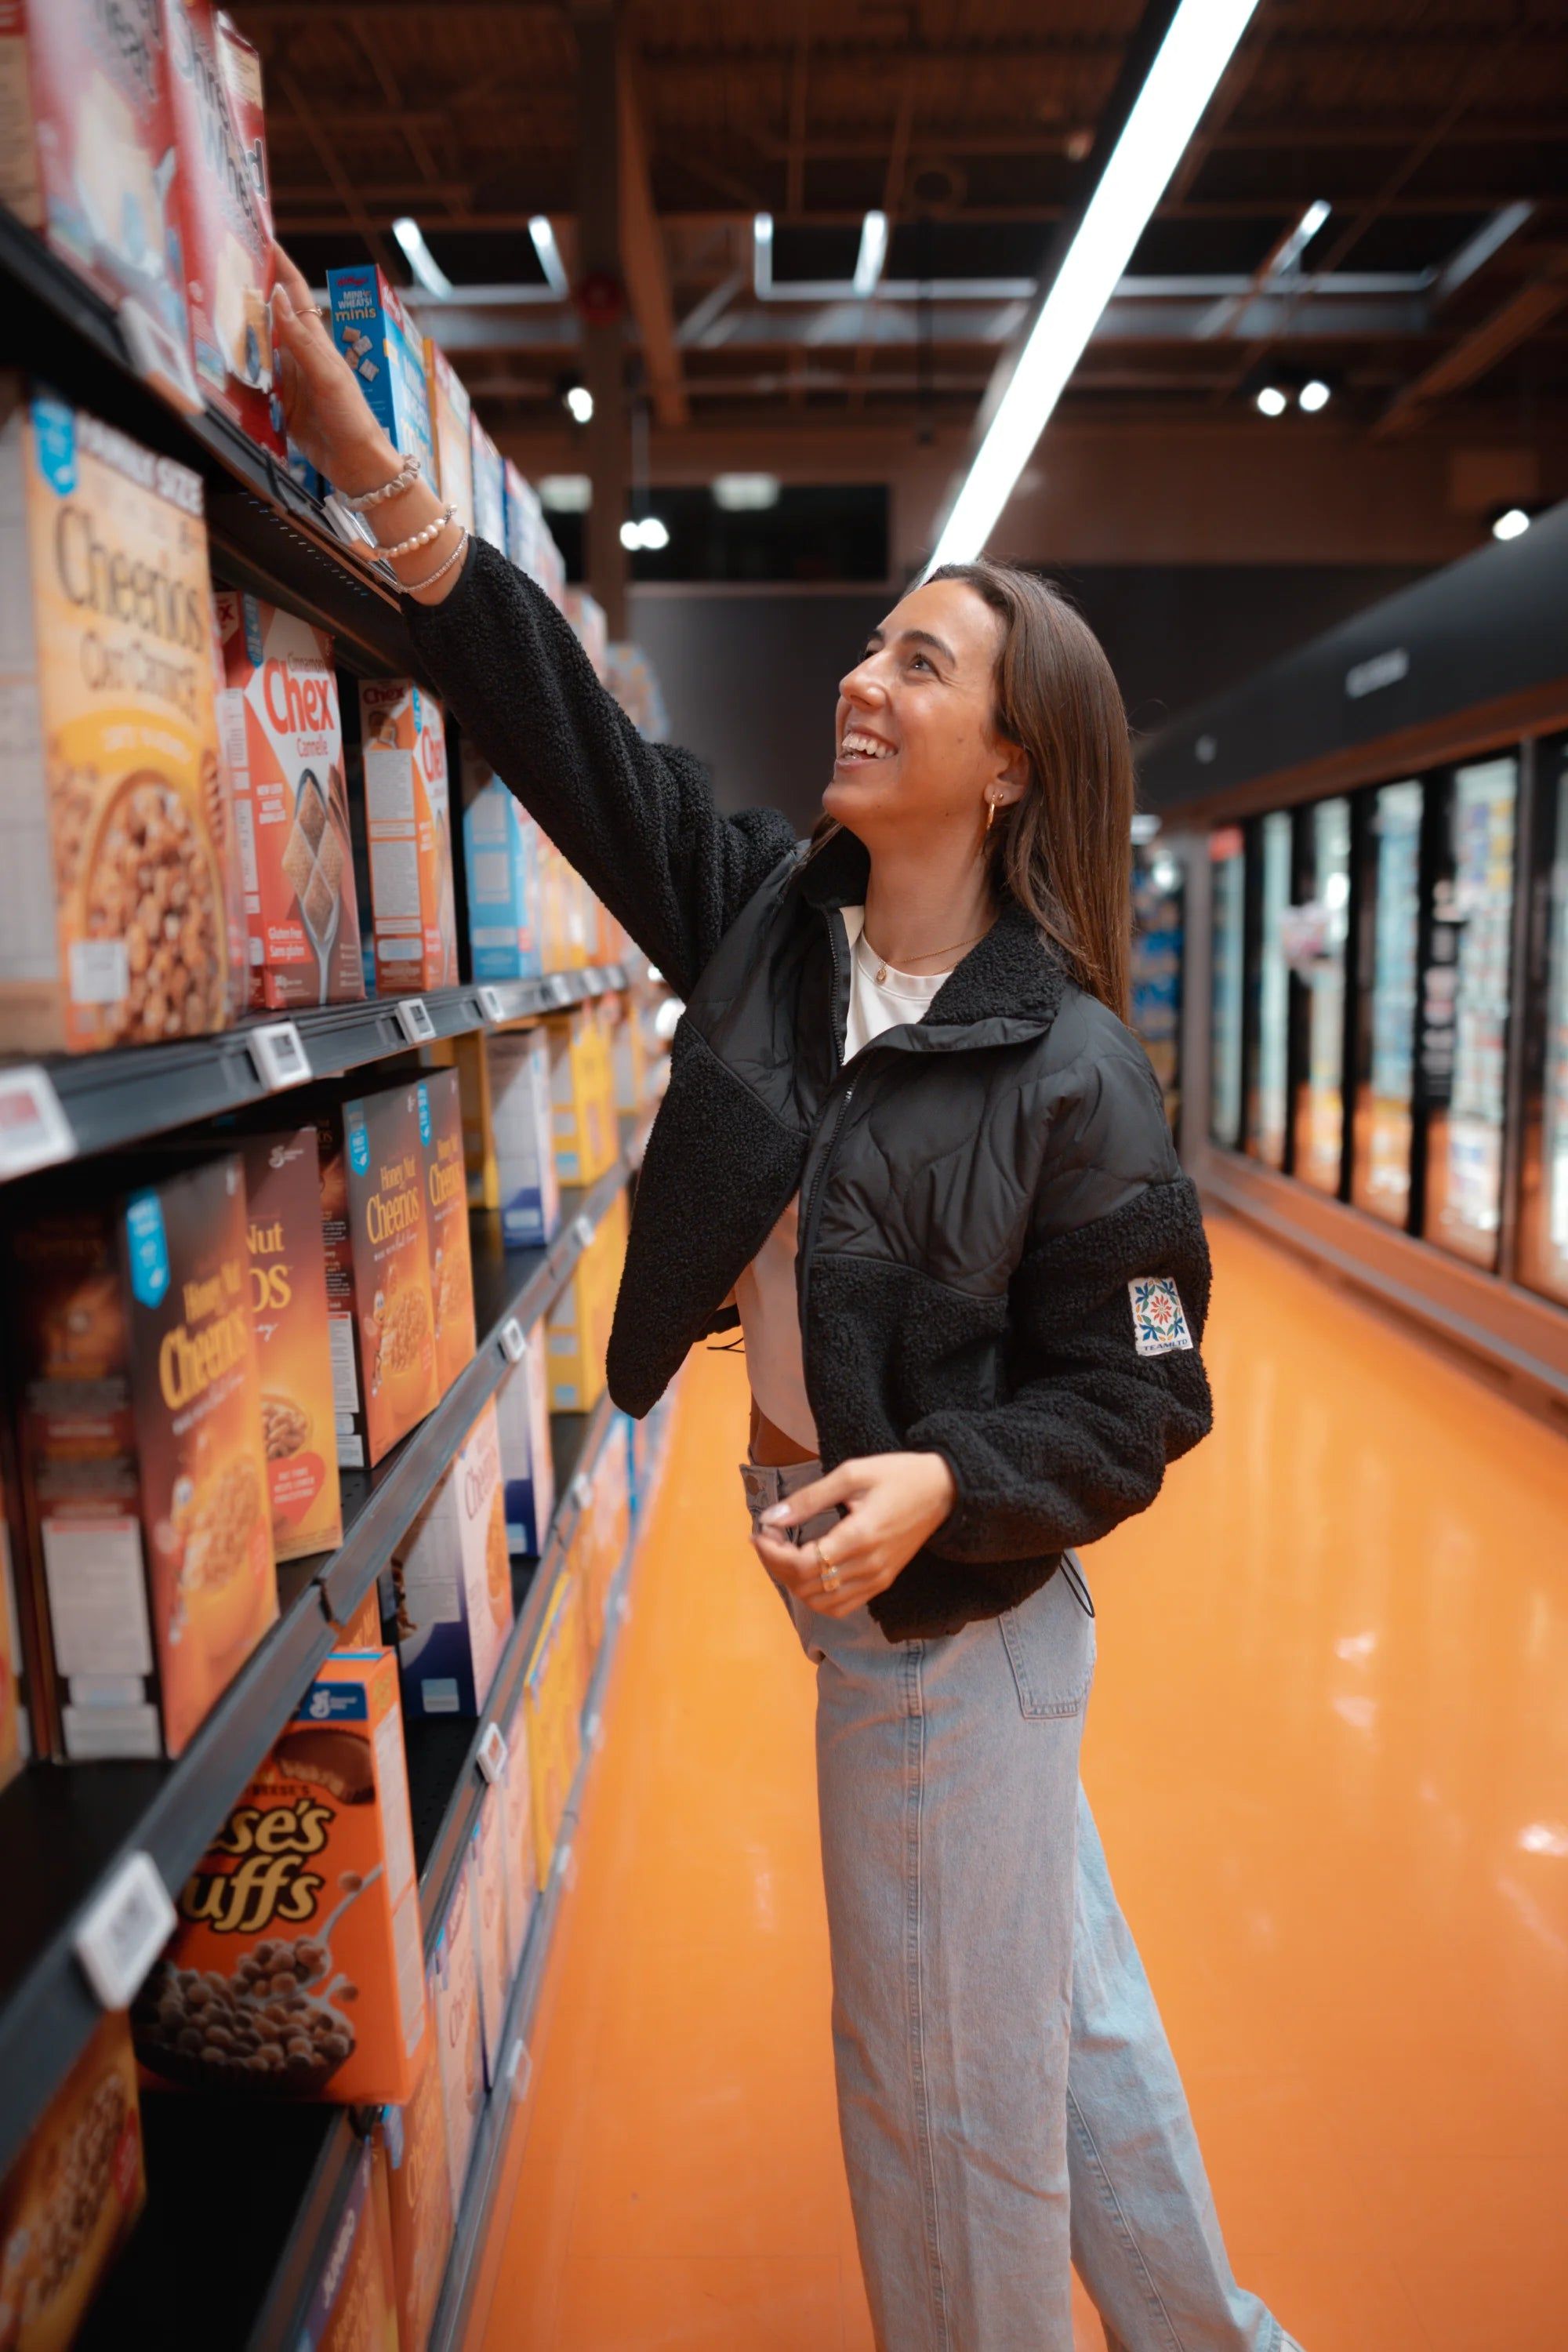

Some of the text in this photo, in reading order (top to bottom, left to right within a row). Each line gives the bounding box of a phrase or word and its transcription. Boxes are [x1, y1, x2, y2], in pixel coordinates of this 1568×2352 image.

[335, 307, 376, 321] minis
[263, 657, 335, 735] Chex
[380, 1153, 416, 1192] Honey Nut
[365, 1185, 420, 1245] Cheerios
[1145, 1338, 1187, 1351] TEAMLTD
[210, 1799, 332, 1855] se's
[182, 1854, 321, 1932] uffs
